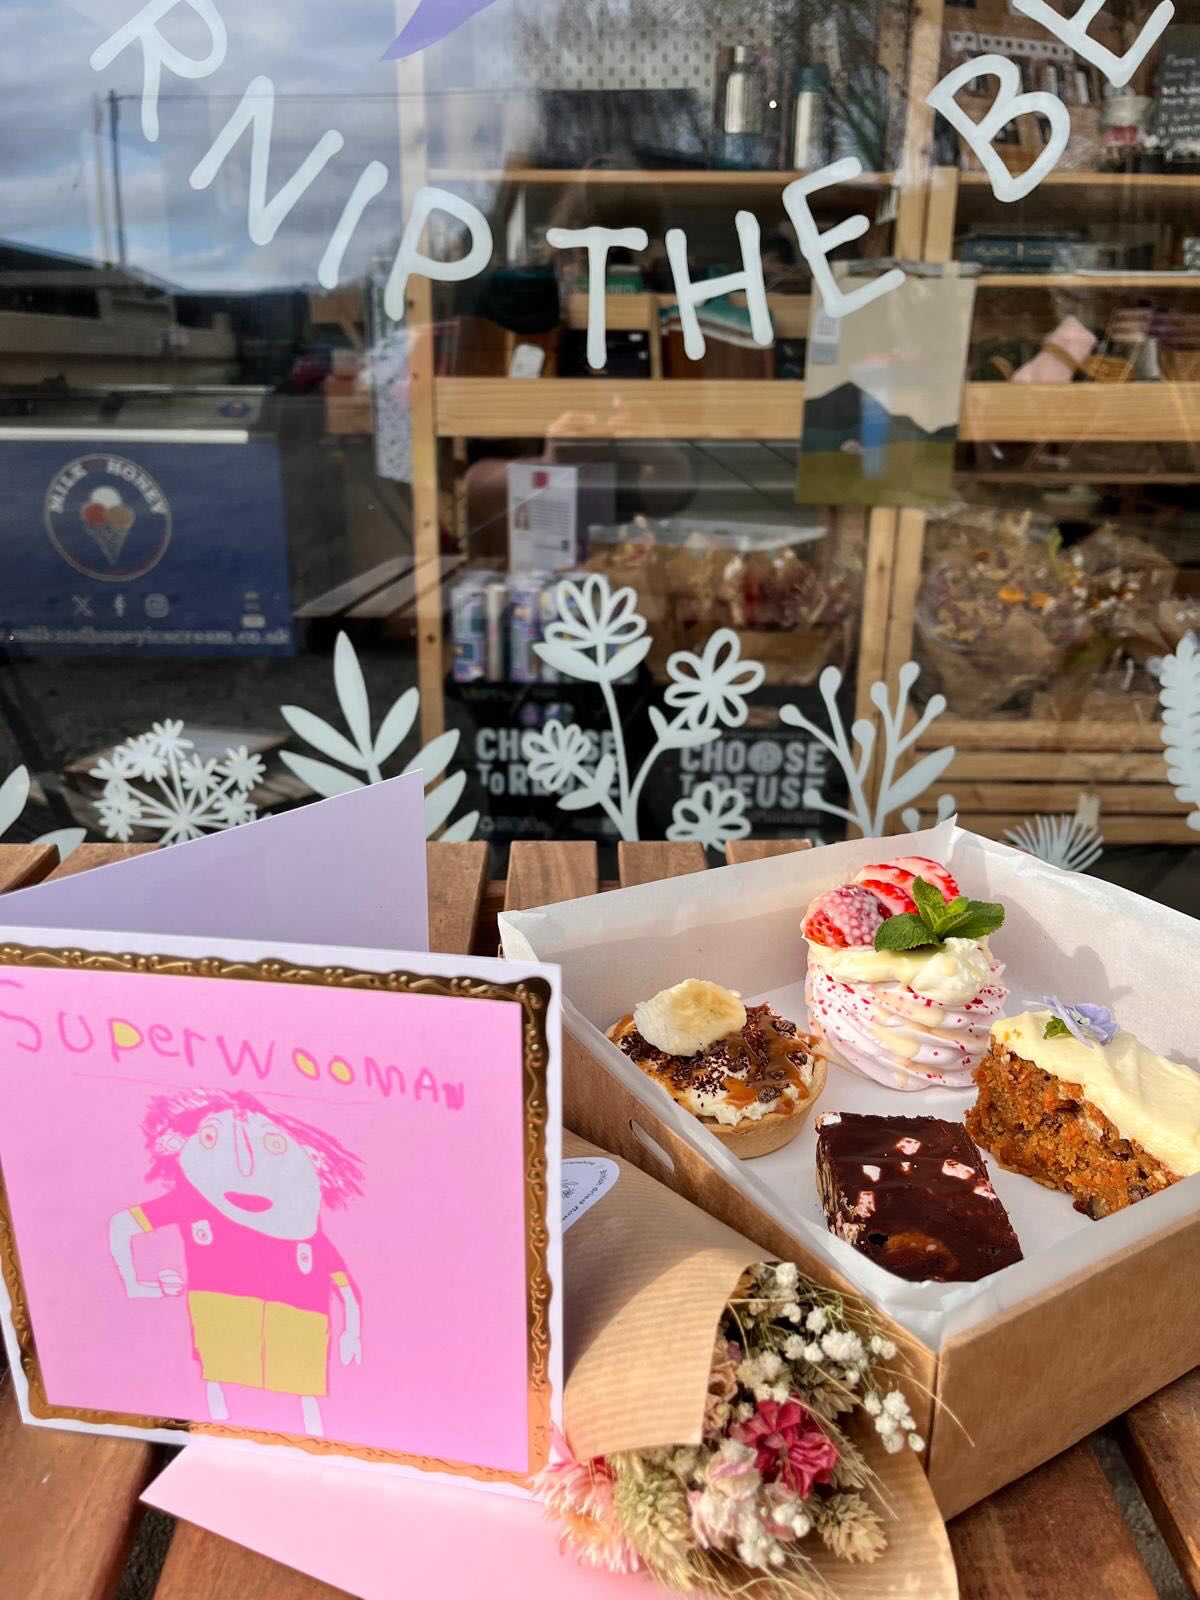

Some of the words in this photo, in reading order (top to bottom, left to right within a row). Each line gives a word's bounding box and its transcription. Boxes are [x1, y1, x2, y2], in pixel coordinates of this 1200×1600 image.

[546, 156, 907, 370] THE
[49, 463, 89, 514] MILK
[106, 458, 168, 514] HONEY
[680, 739, 828, 775] CHOOSE
